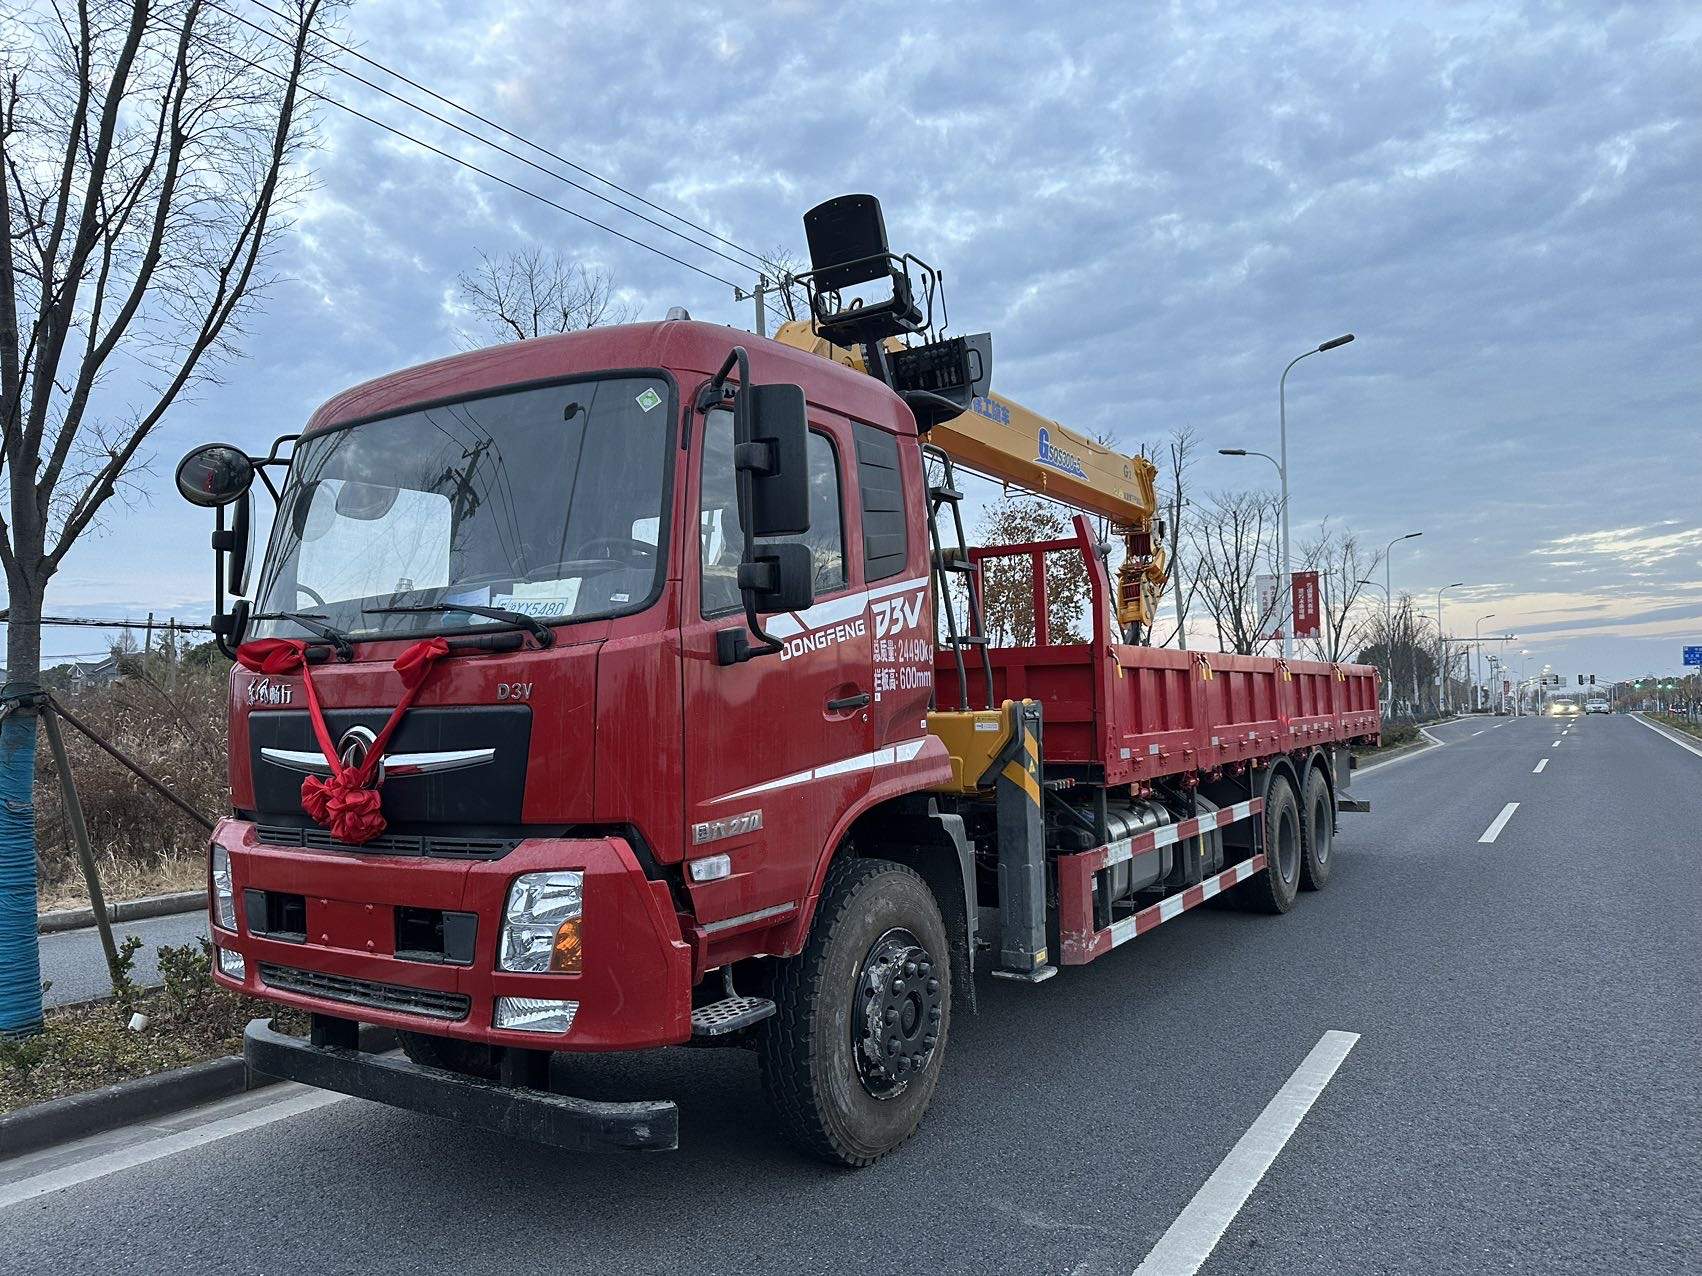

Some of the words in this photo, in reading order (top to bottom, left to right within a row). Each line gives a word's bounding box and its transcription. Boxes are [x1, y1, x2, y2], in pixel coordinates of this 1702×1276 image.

[870, 591, 925, 639] D3V
[779, 619, 866, 661] DONGFENG
[497, 682, 533, 700] D3V
